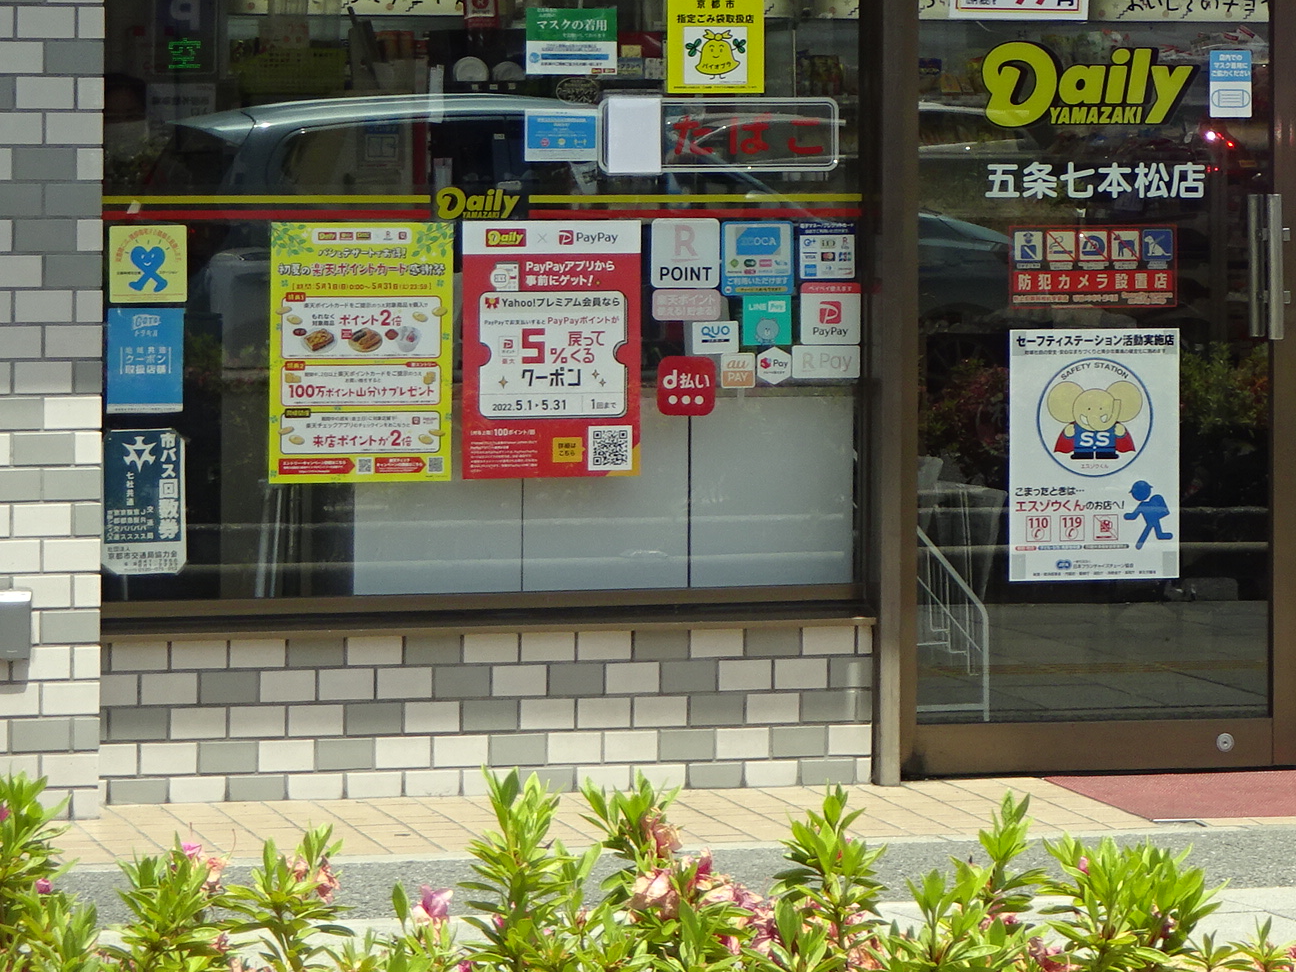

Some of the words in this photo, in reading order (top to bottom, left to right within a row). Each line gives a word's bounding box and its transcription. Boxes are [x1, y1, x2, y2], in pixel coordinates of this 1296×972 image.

[696, 0, 735, 9] 京都市
[537, 19, 607, 31] マスクの着用
[676, 13, 754, 24] 指定ごみ袋取扱店
[981, 40, 1200, 127] Daily
[1050, 106, 1142, 124] YAMAZAKI
[672, 112, 824, 156] たばこ
[985, 161, 1206, 200] 五条七本松店
[435, 186, 521, 220] Daily
[462, 211, 500, 219] YAMAZAKI
[488, 231, 524, 245] Daily
[576, 232, 618, 244] PayPay
[525, 261, 615, 273] PayPayアプリから
[525, 275, 593, 286] 事前にゲット!
[660, 267, 712, 281] POINT
[1018, 273, 1168, 290] 防犯カメラ設置店
[502, 297, 620, 308] Yahoo!プレミアム会員なら
[749, 303, 767, 311] LINE
[701, 325, 730, 338] QUO
[813, 327, 848, 338] PayPay
[1016, 334, 1175, 348] セーフティステーション活動実施店
[727, 359, 748, 370] au
[773, 360, 789, 369] Pay
[820, 353, 852, 373] Pay
[521, 367, 581, 387] クーポン
[728, 373, 749, 382] PAY
[1060, 362, 1092, 381] SAFETY
[1094, 362, 1130, 379] STATION
[663, 369, 710, 389] d払い
[158, 433, 180, 539] 市バス回数券
[1028, 517, 1049, 529] 110
[1061, 516, 1083, 528] 119
